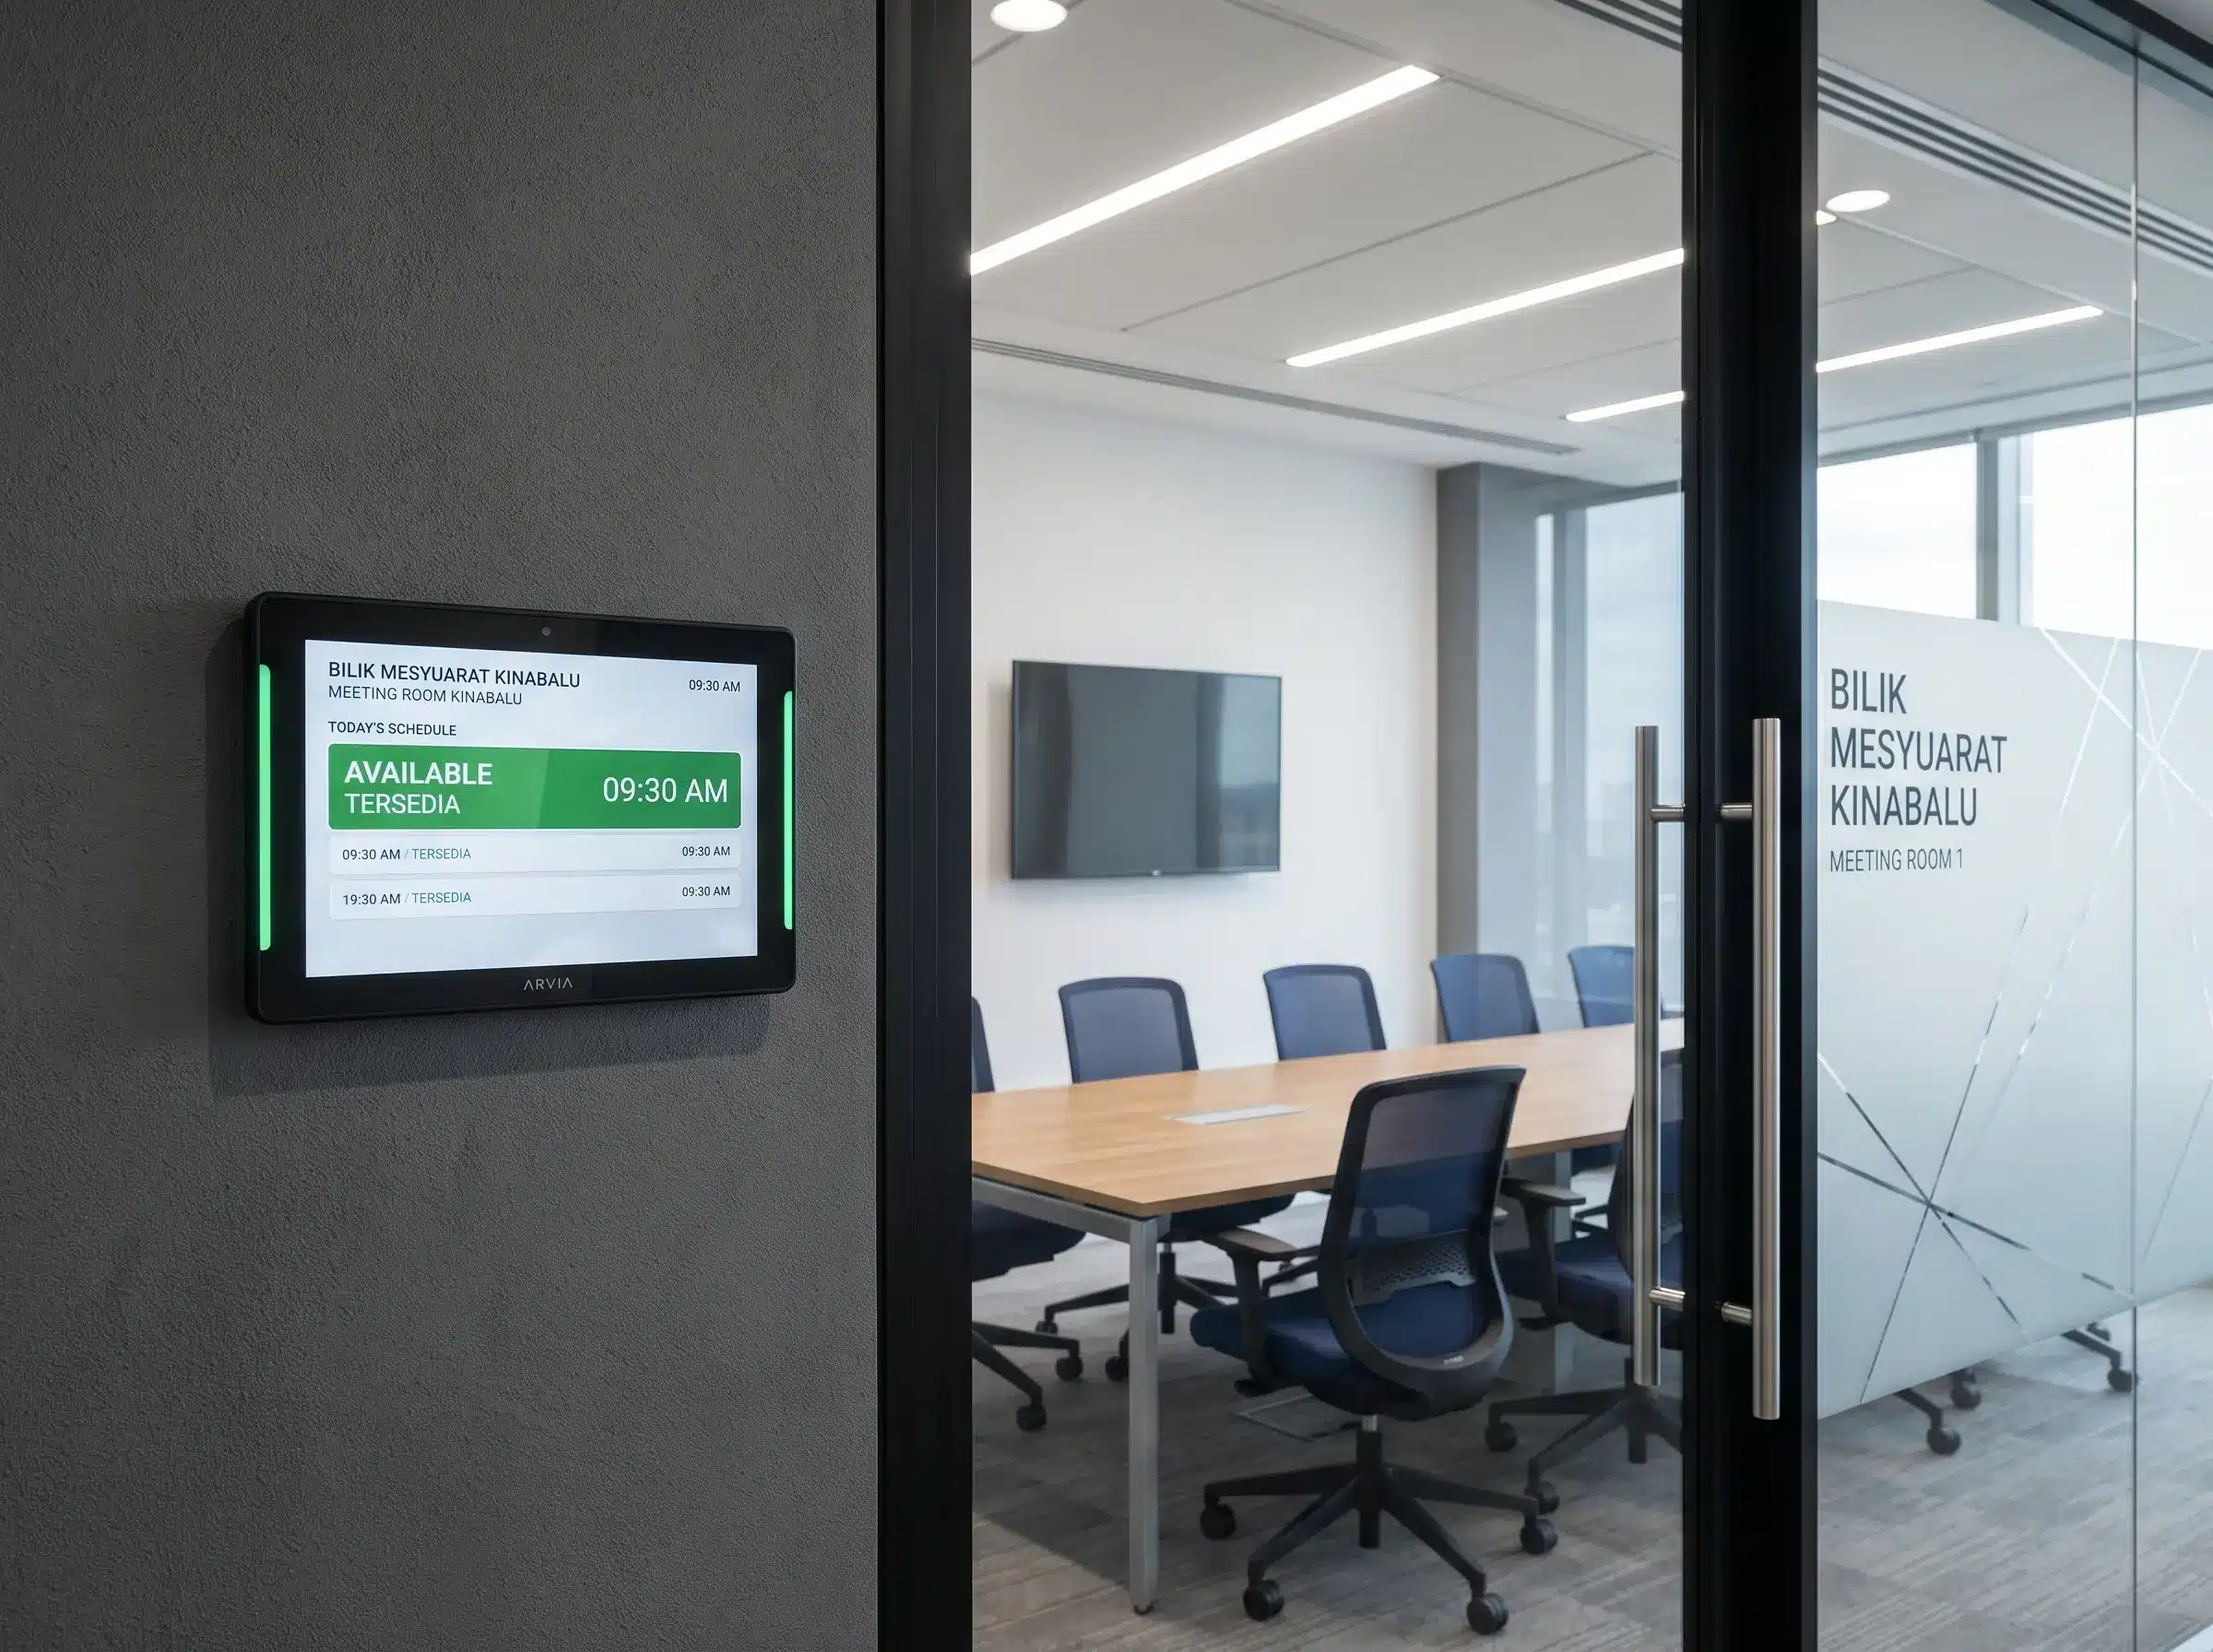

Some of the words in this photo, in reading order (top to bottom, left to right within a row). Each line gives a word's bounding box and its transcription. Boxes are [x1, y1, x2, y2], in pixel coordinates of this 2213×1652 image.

[329, 661, 375, 678] BILIK
[381, 666, 491, 684] MESYUARAT
[495, 669, 581, 688] KINABALU
[329, 686, 397, 702] MEETING
[403, 689, 446, 702] ROOM
[451, 690, 522, 705] KINABALU
[688, 679, 719, 692] 09:30
[722, 680, 740, 692] AM
[1831, 668, 1907, 714] BILIK
[328, 721, 385, 735] TODAY'S
[388, 723, 456, 737] SCHEDULE
[1831, 726, 2007, 773] MESYUARAT
[344, 761, 492, 785] AVAILABLE
[602, 776, 677, 803] 09:30
[684, 779, 728, 803] AM
[345, 793, 461, 814] TERSEDIA
[1831, 785, 1976, 826] KINABALU
[342, 848, 376, 861] 09:30
[381, 848, 401, 860] AM
[411, 848, 471, 860] TERSEDIA
[681, 845, 711, 857] 09:30
[713, 845, 730, 856] AM
[1830, 849, 1901, 872] MEETING
[1907, 848, 1951, 870] ROOM
[1957, 848, 1962, 868] 1
[343, 893, 376, 905] 19:30
[381, 893, 401, 905] AM
[411, 892, 471, 903] TERSEDIA
[681, 886, 711, 897] 09:30
[713, 886, 730, 897] AM
[524, 977, 573, 991] ARVIA
